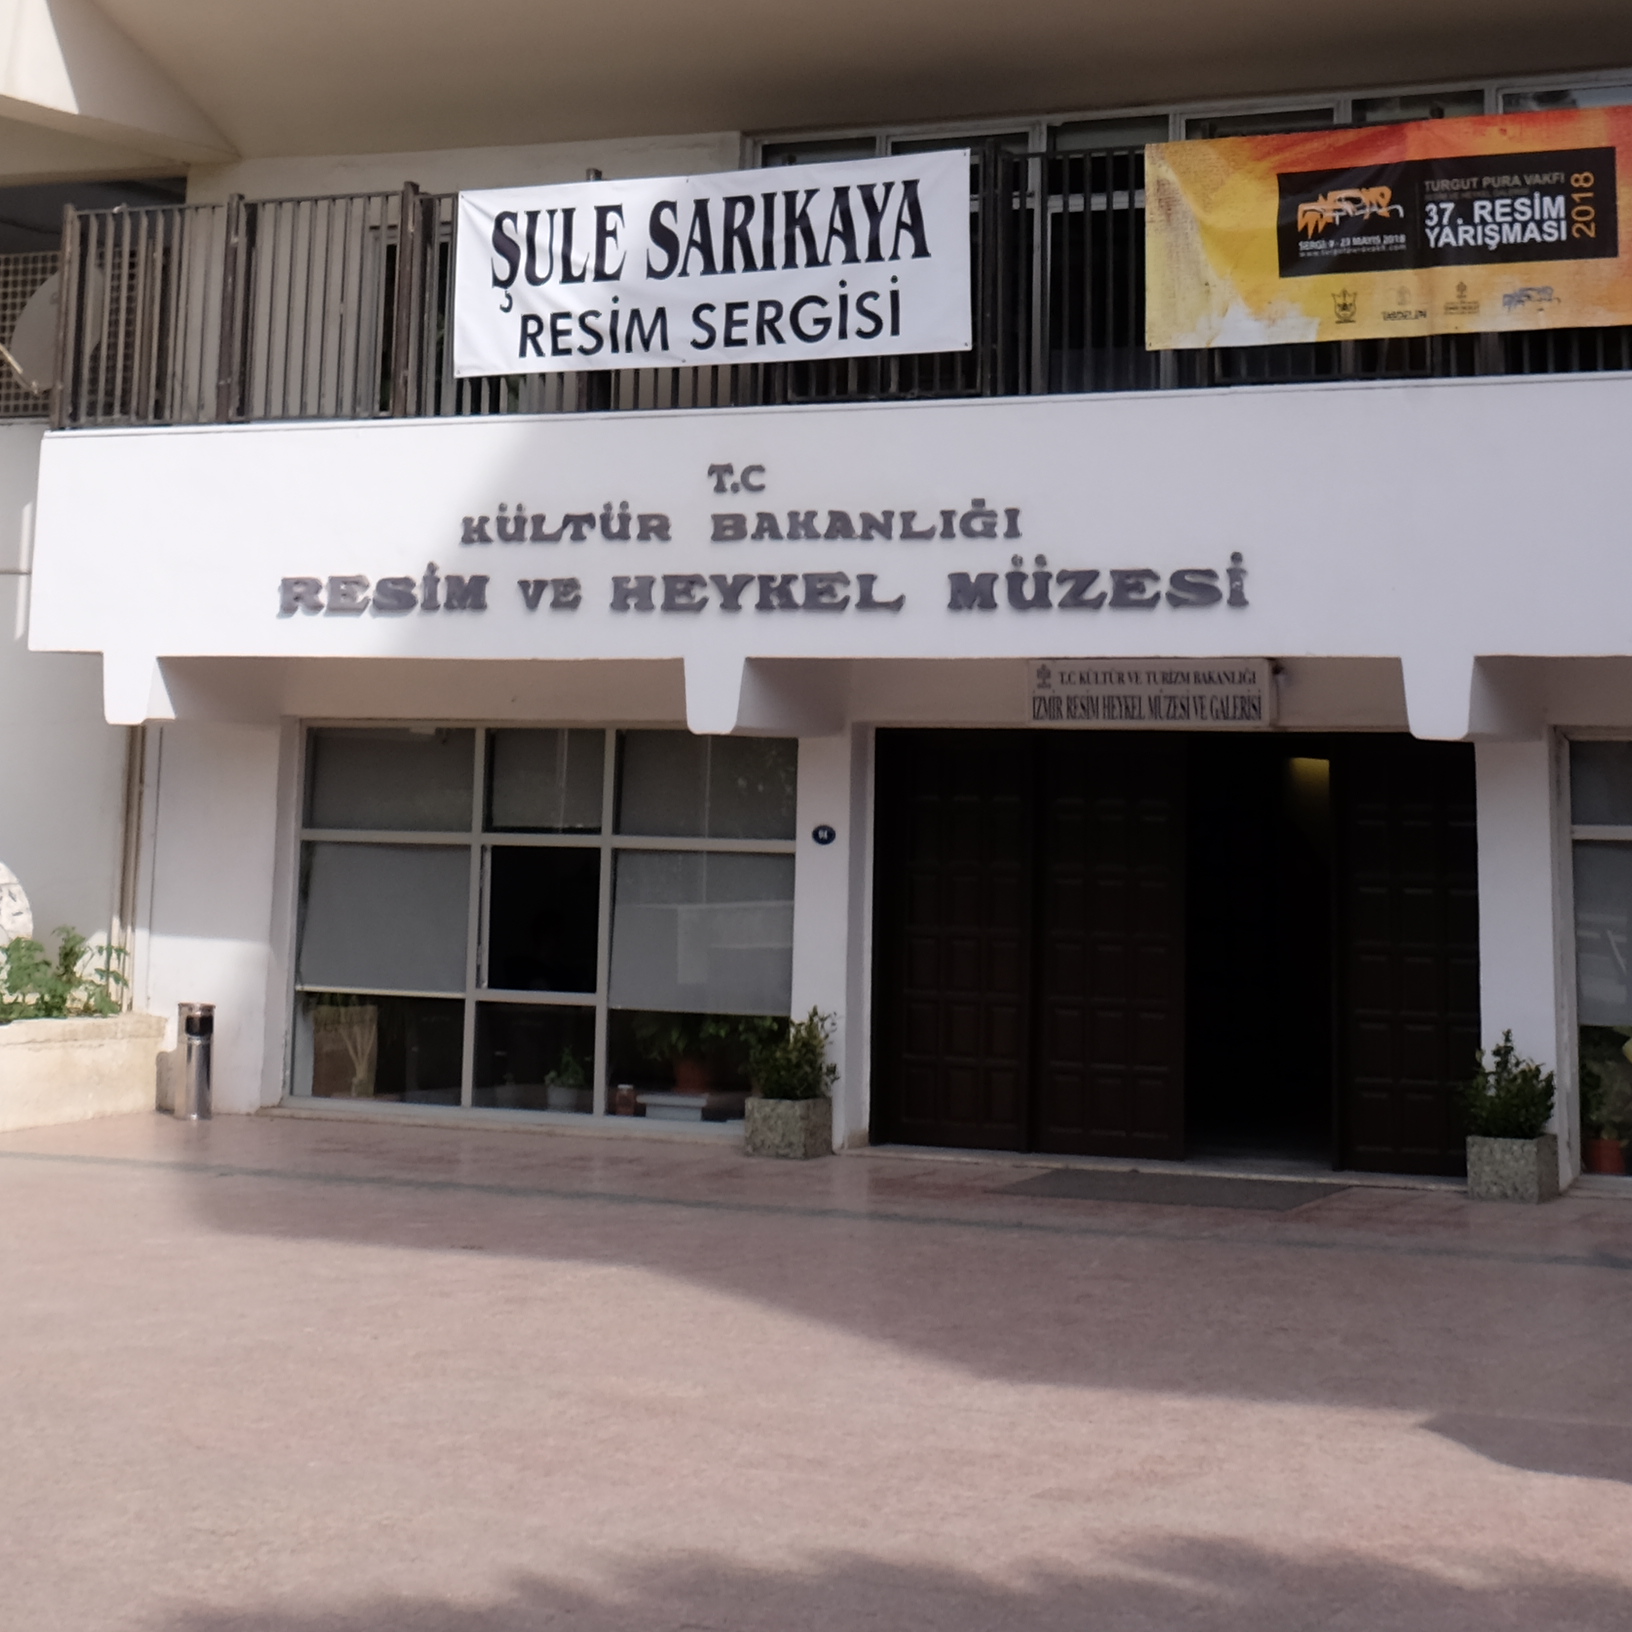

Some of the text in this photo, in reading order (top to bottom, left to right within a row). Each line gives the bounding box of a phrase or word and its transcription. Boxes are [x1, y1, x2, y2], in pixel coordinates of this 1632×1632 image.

[1424, 177, 1478, 193] TURGUT
[1482, 174, 1521, 188] PURA
[1424, 202, 1464, 226] 37.
[1473, 190, 1566, 224] RESİM
[1570, 171, 1596, 238] 2018
[490, 178, 932, 313] ŞULE SARIKAYA
[1424, 220, 1567, 251] YARIŞMASI
[519, 275, 900, 358] RESİM SERGİSİ
[708, 463, 766, 493] T.C
[460, 498, 1023, 545] KÜLTÜR BAKANLIĞI
[277, 551, 1248, 618] RESİM VE HEYKEL MÜZESİ
[1079, 668, 1125, 685] KÜLTÜR
[1127, 671, 1142, 685] VE
[1145, 668, 1190, 685] TURİZM
[1193, 667, 1256, 685] BAKANLIĞI
[1032, 688, 1261, 720] İZMİR RESİM HEYKEL MÜZESİ VE GALERİSİ
